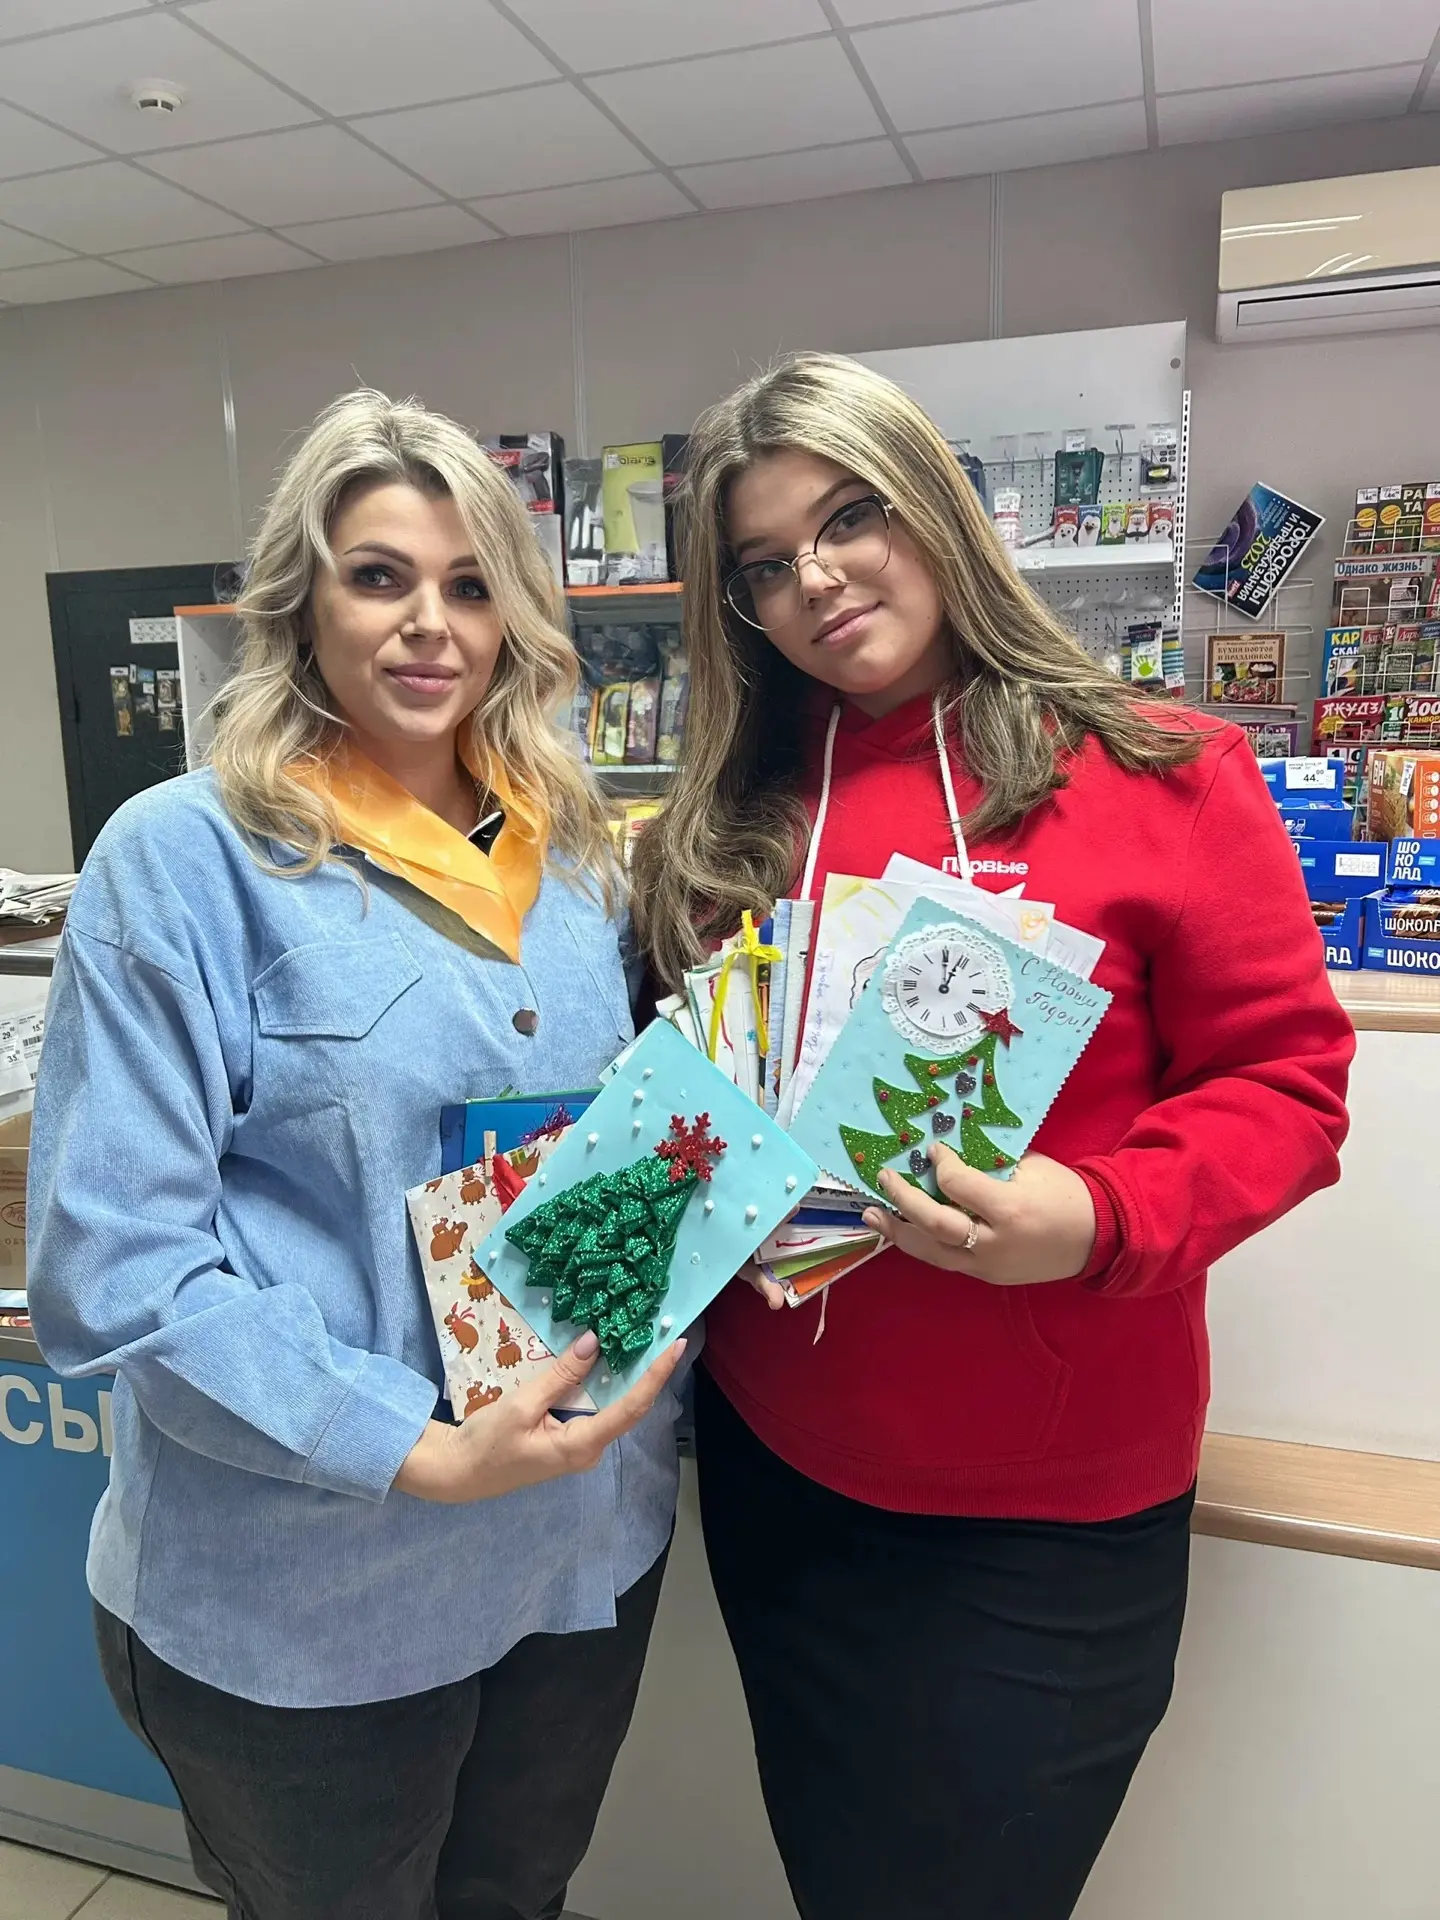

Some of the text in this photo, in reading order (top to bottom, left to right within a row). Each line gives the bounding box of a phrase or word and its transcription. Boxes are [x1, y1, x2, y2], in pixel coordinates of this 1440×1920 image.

[1289, 512, 1300, 523] И
[1237, 521, 1294, 601] ПРЕДСКАЗАНИЯ
[1240, 532, 1272, 572] 2025
[1249, 521, 1311, 605] ГОРОСКОПЫ
[1337, 559, 1424, 576] Однако жизнь!
[1397, 841, 1420, 854] ШО
[942, 856, 1029, 876] Првые
[1394, 854, 1414, 867] КО
[1392, 867, 1422, 881] ЛАД
[1021, 957, 1040, 976] С
